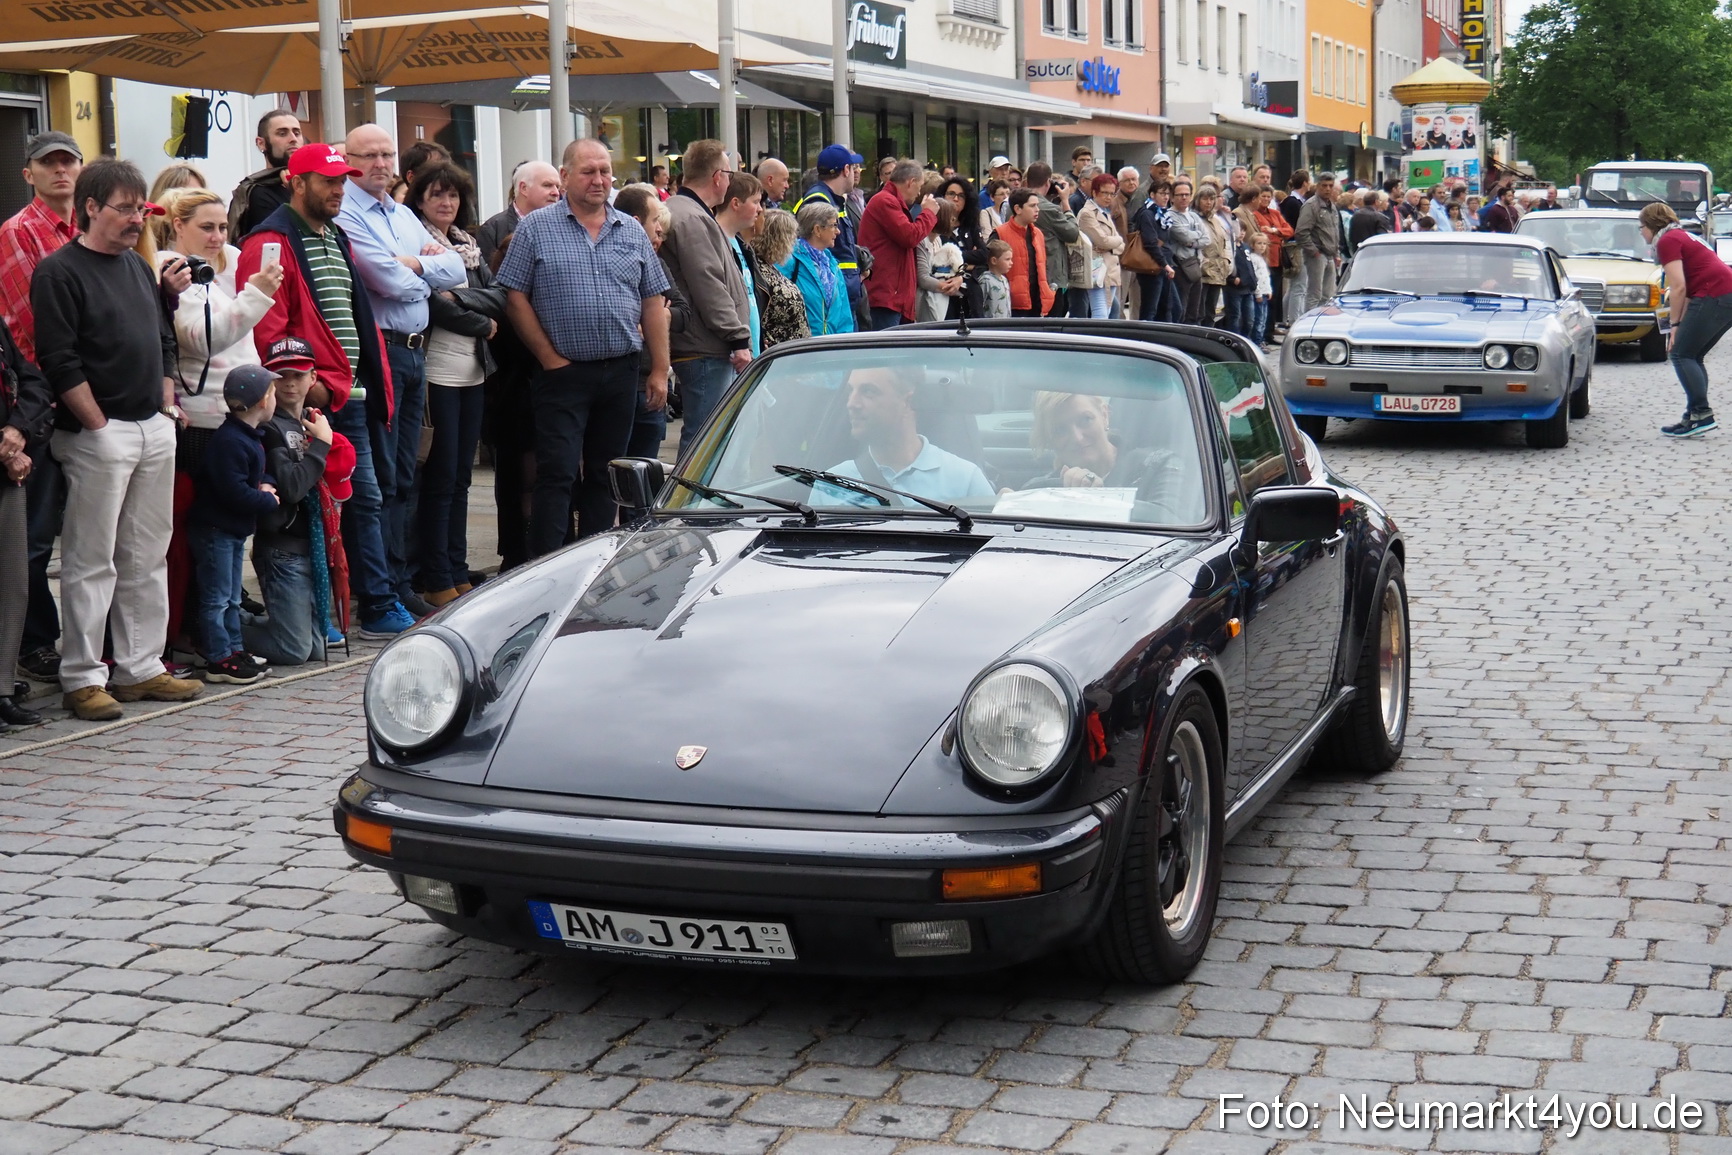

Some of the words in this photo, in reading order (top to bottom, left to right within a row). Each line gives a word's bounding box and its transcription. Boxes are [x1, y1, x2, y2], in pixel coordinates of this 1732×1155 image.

[846, 2, 906, 60] frühauf
[1463, 0, 1483, 73] HOT
[76, 102, 92, 121] 24
[272, 340, 287, 355] NEW
[1383, 397, 1412, 410] LAU
[1421, 398, 1457, 411] 0728
[543, 922, 553, 932] D
[565, 909, 620, 942] AM
[760, 926, 780, 935] 03
[768, 946, 785, 954] 10
